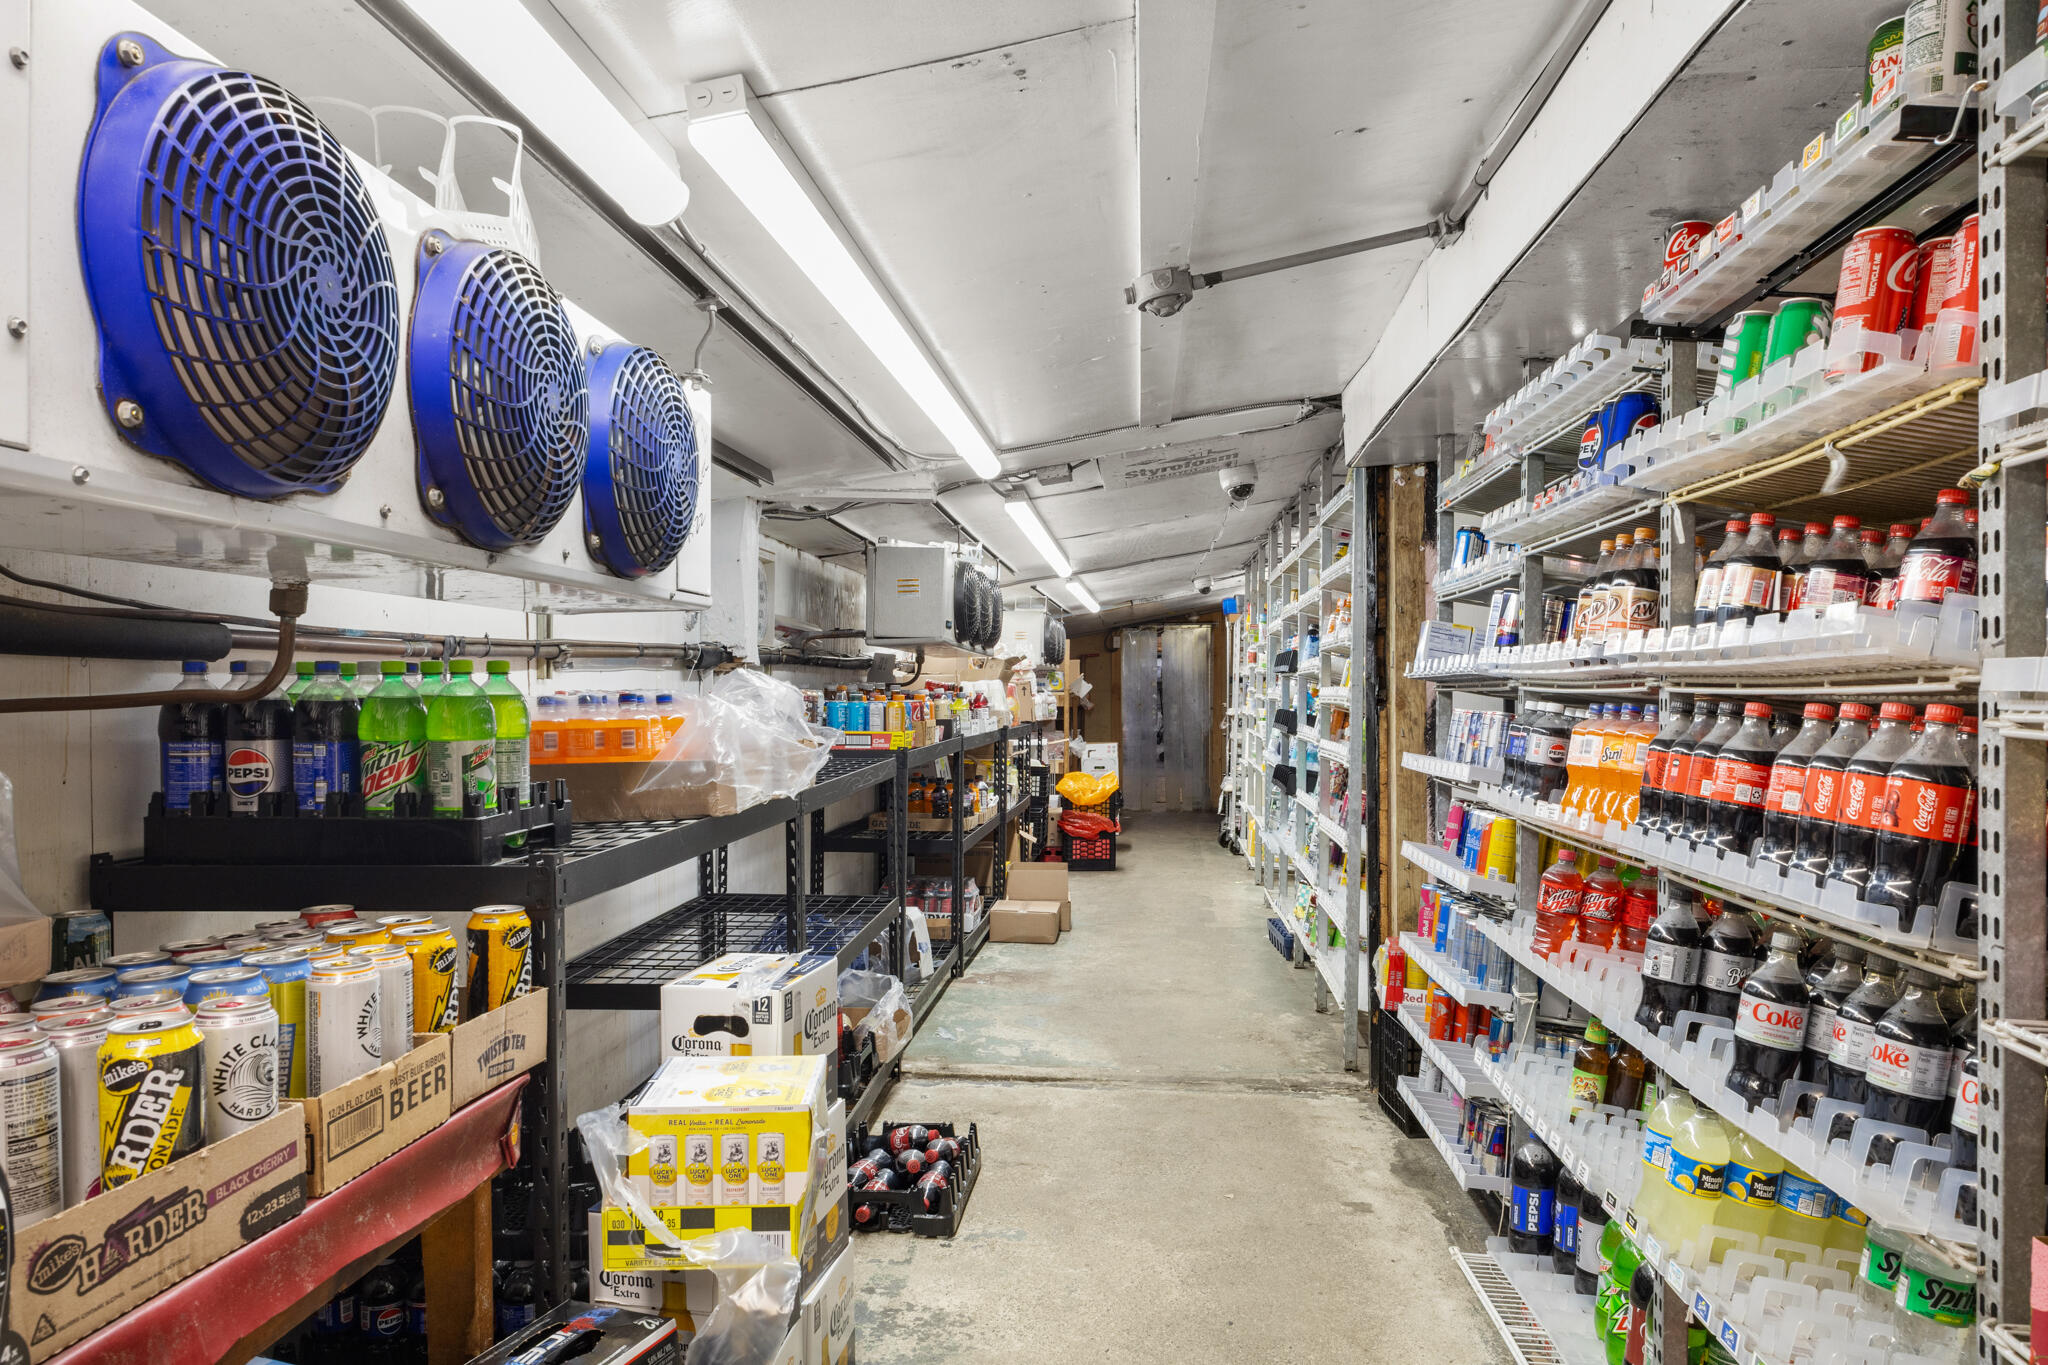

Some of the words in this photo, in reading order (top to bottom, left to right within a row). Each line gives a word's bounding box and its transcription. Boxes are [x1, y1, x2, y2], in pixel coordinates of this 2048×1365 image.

[1868, 265, 1881, 297] RECYCLE
[1875, 252, 1882, 265] ME
[1963, 256, 1974, 288] RECYCLE
[228, 768, 270, 779] PEPSI
[1814, 773, 1833, 814] Coca-Cola
[1846, 777, 1865, 820] Coca-Cola
[1912, 786, 1937, 832] Coca-Cola
[757, 997, 768, 1012] 12
[1403, 992, 1423, 1003] Red
[356, 992, 379, 1040] WHITE
[804, 1000, 836, 1040] Corona
[1752, 1002, 1804, 1030] Coke
[510, 1034, 526, 1052] TEA
[672, 1034, 722, 1051] Corona
[812, 1030, 830, 1049] Extra
[212, 1042, 248, 1096] WHITE
[250, 1034, 278, 1049] CLA
[390, 1072, 409, 1089] PABST
[409, 1062, 424, 1078] BLUE
[424, 1052, 446, 1070] RIBBON
[1872, 1043, 1910, 1069] oke
[104, 1059, 148, 1088] mike's
[328, 1101, 346, 1120] 12/24
[365, 1084, 382, 1099] CANS
[390, 1063, 447, 1121] BEER
[111, 1068, 185, 1176] RDER
[230, 1102, 262, 1117] HARD
[689, 1118, 706, 1126] Vodka
[714, 1118, 734, 1126] REAL
[736, 1118, 766, 1126] Lemonade
[8, 1142, 38, 1154] Calories
[149, 1106, 185, 1172] ONADE
[215, 1172, 250, 1201] BLACK
[252, 1148, 290, 1179] CHERRY
[1702, 1174, 1724, 1184] Minute
[1704, 1182, 1720, 1190] Maid
[1754, 1182, 1776, 1192] Minute
[1756, 1189, 1773, 1198] Maid
[246, 1194, 286, 1226] 12x23.5
[1528, 1192, 1540, 1232] PEPSI
[36, 1244, 81, 1284] mike's
[600, 1270, 653, 1289] Corona
[610, 1286, 640, 1299] Extra
